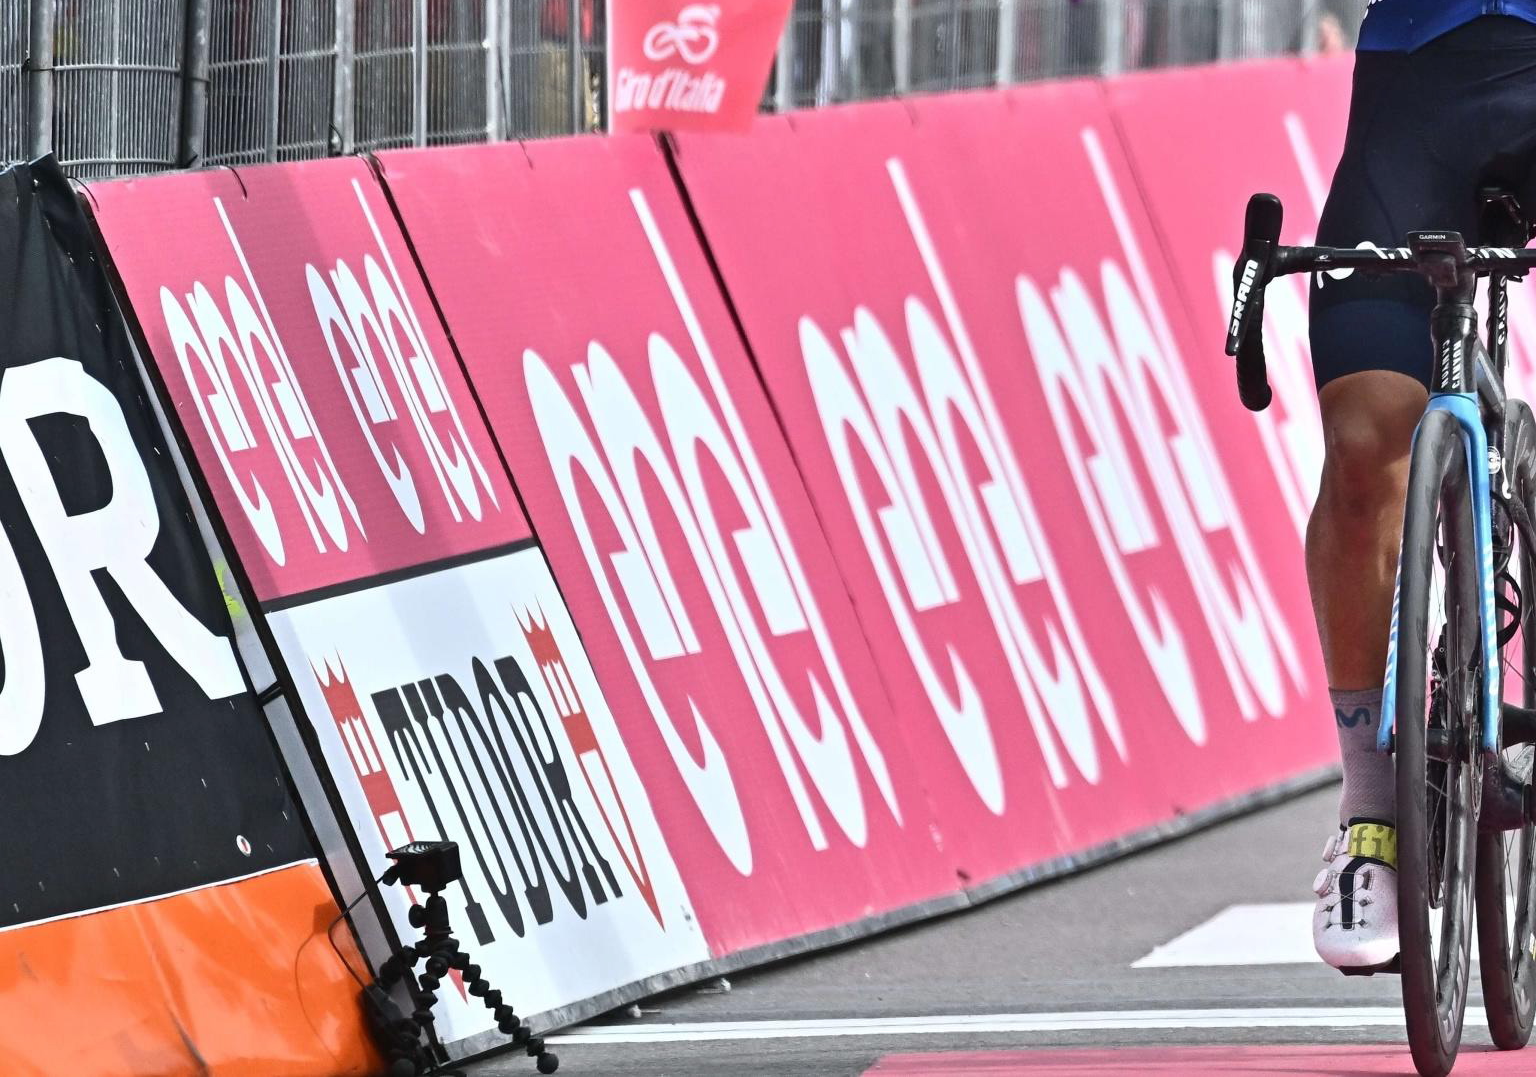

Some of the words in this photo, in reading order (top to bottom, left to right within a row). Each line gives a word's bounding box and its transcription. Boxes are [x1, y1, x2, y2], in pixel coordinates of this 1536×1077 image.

[160, 197, 366, 567] enel
[306, 179, 501, 535] enel
[1015, 129, 1307, 746] enel
[1229, 259, 1259, 337] SRAM
[1441, 338, 1451, 389] CANYON
[1452, 340, 1462, 389] CANYON
[523, 189, 902, 876] enel
[798, 158, 1127, 815] enel
[371, 655, 623, 946] TUDOR
